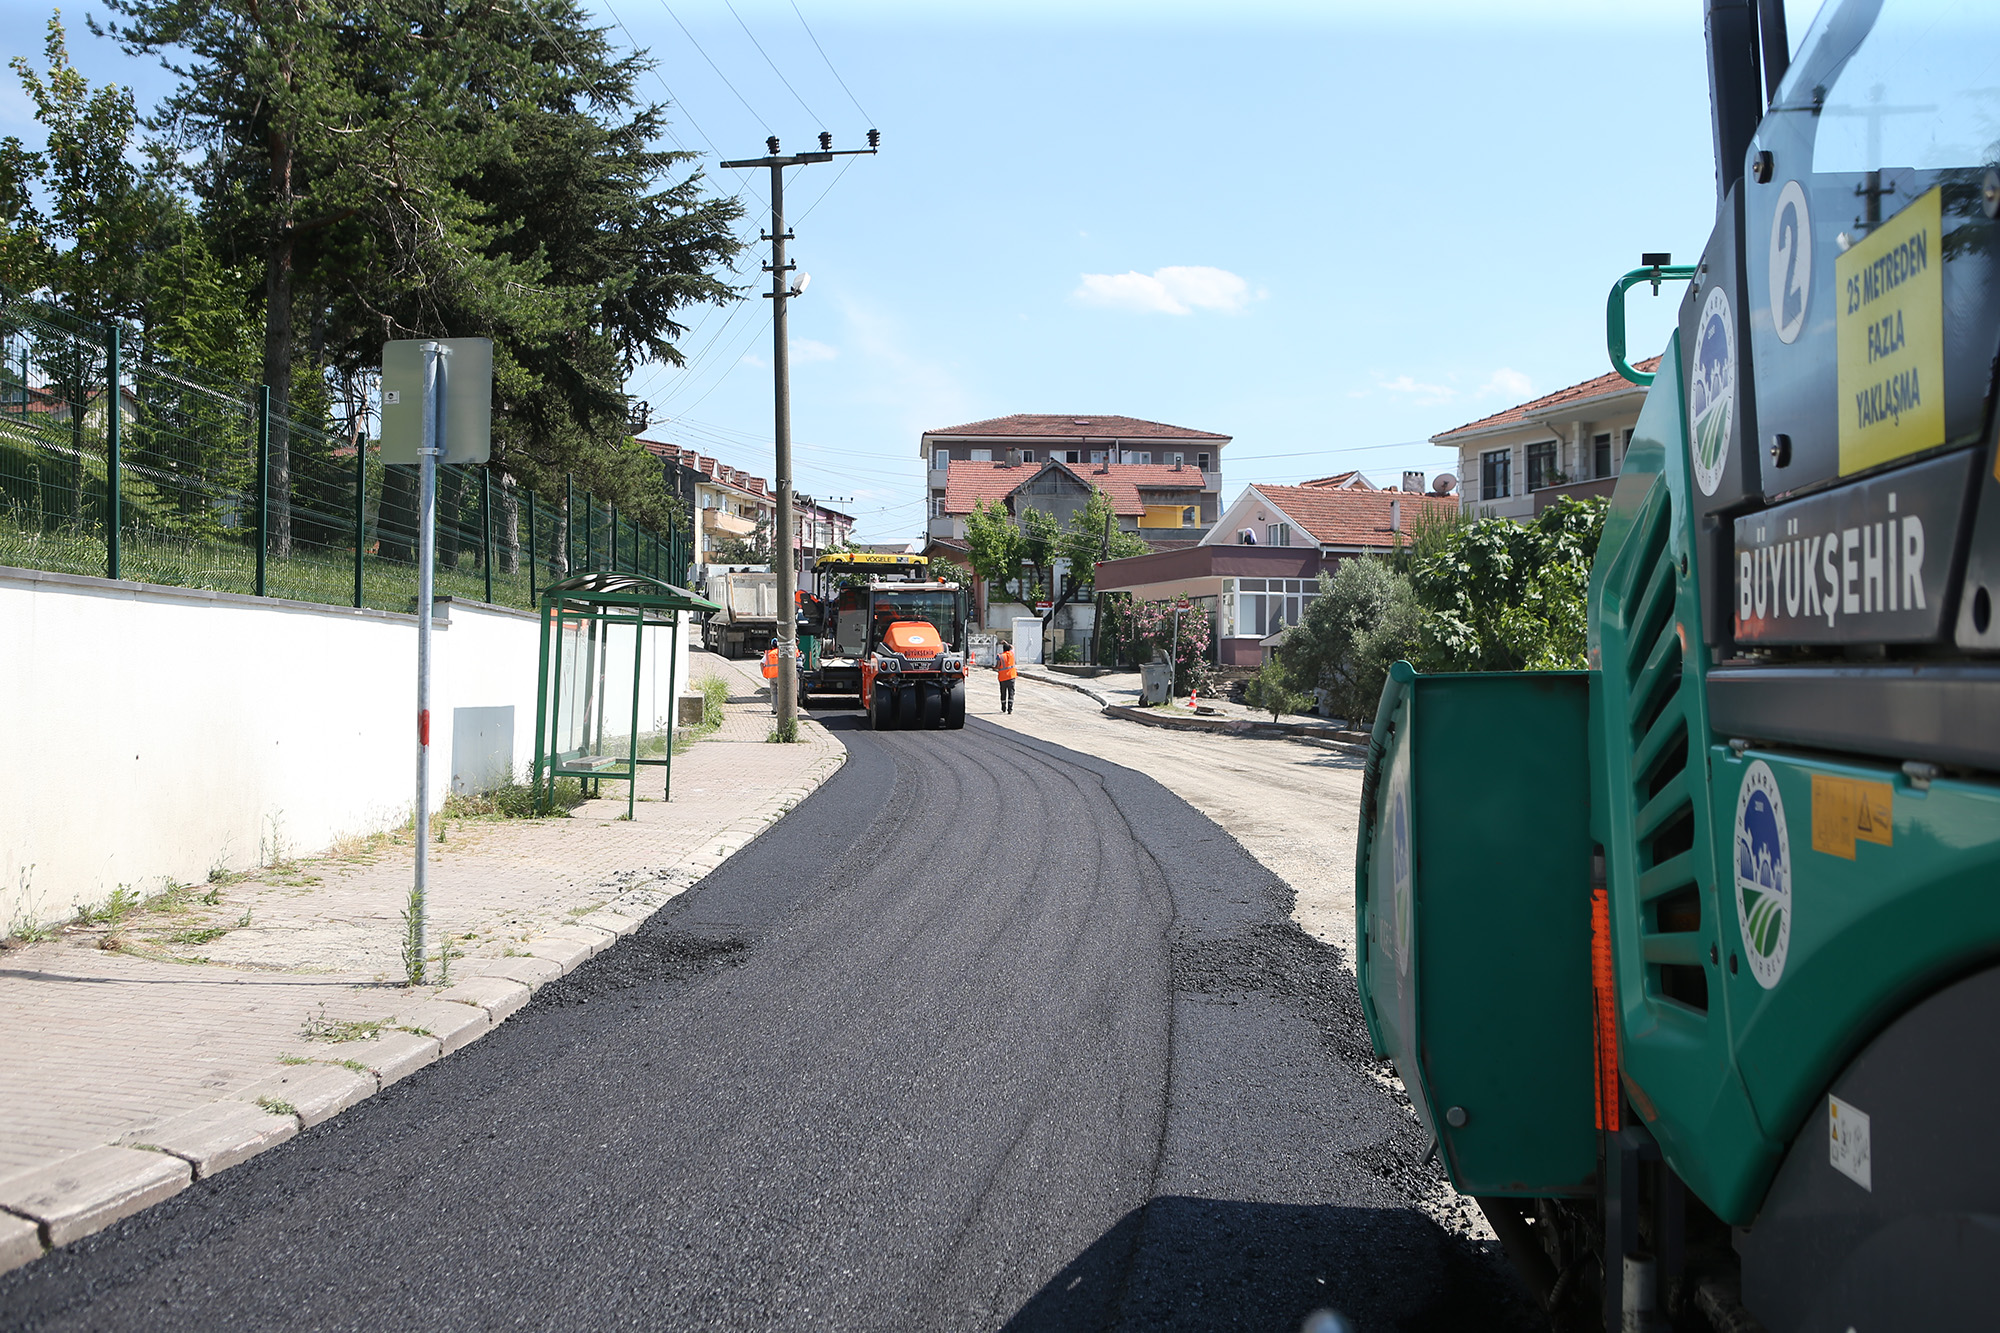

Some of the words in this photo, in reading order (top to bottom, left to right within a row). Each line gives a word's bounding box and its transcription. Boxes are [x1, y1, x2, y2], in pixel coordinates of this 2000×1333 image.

[1778, 201, 1802, 331] 2
[1846, 273, 1860, 316] 25
[1863, 228, 1928, 306] METREDEN
[1868, 308, 1906, 365] FAZLA
[1856, 367, 1921, 427] YAKLAŞMA
[1740, 491, 1927, 628] BÜYÜKŞEHİR
